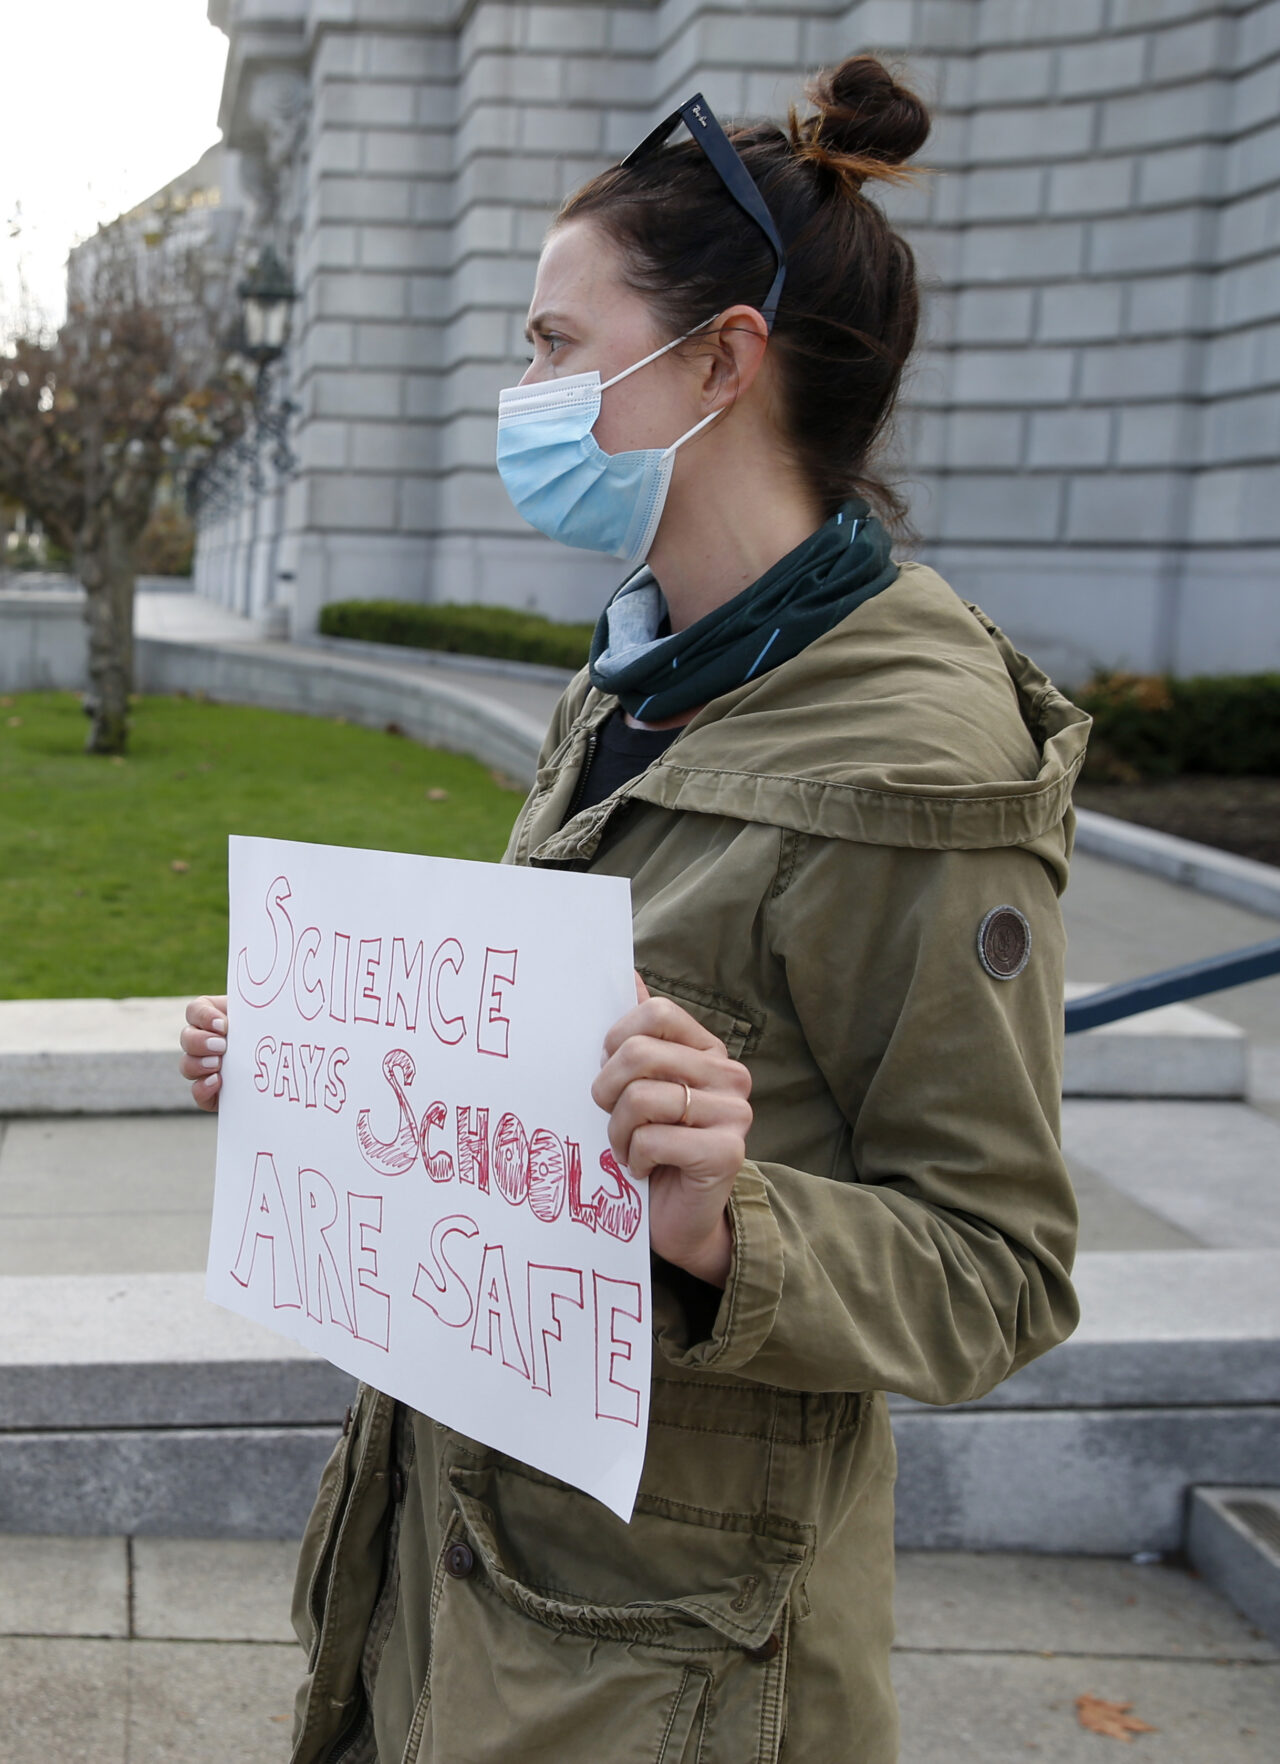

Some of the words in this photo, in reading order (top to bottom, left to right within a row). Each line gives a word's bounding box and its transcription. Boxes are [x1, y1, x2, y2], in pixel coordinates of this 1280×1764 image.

[236, 875, 518, 1059] SCIENCE
[253, 1035, 350, 1113] SAYS
[355, 1048, 643, 1242] SCHOOLS
[230, 1151, 390, 1353] ARE
[412, 1214, 642, 1428] SAFE
